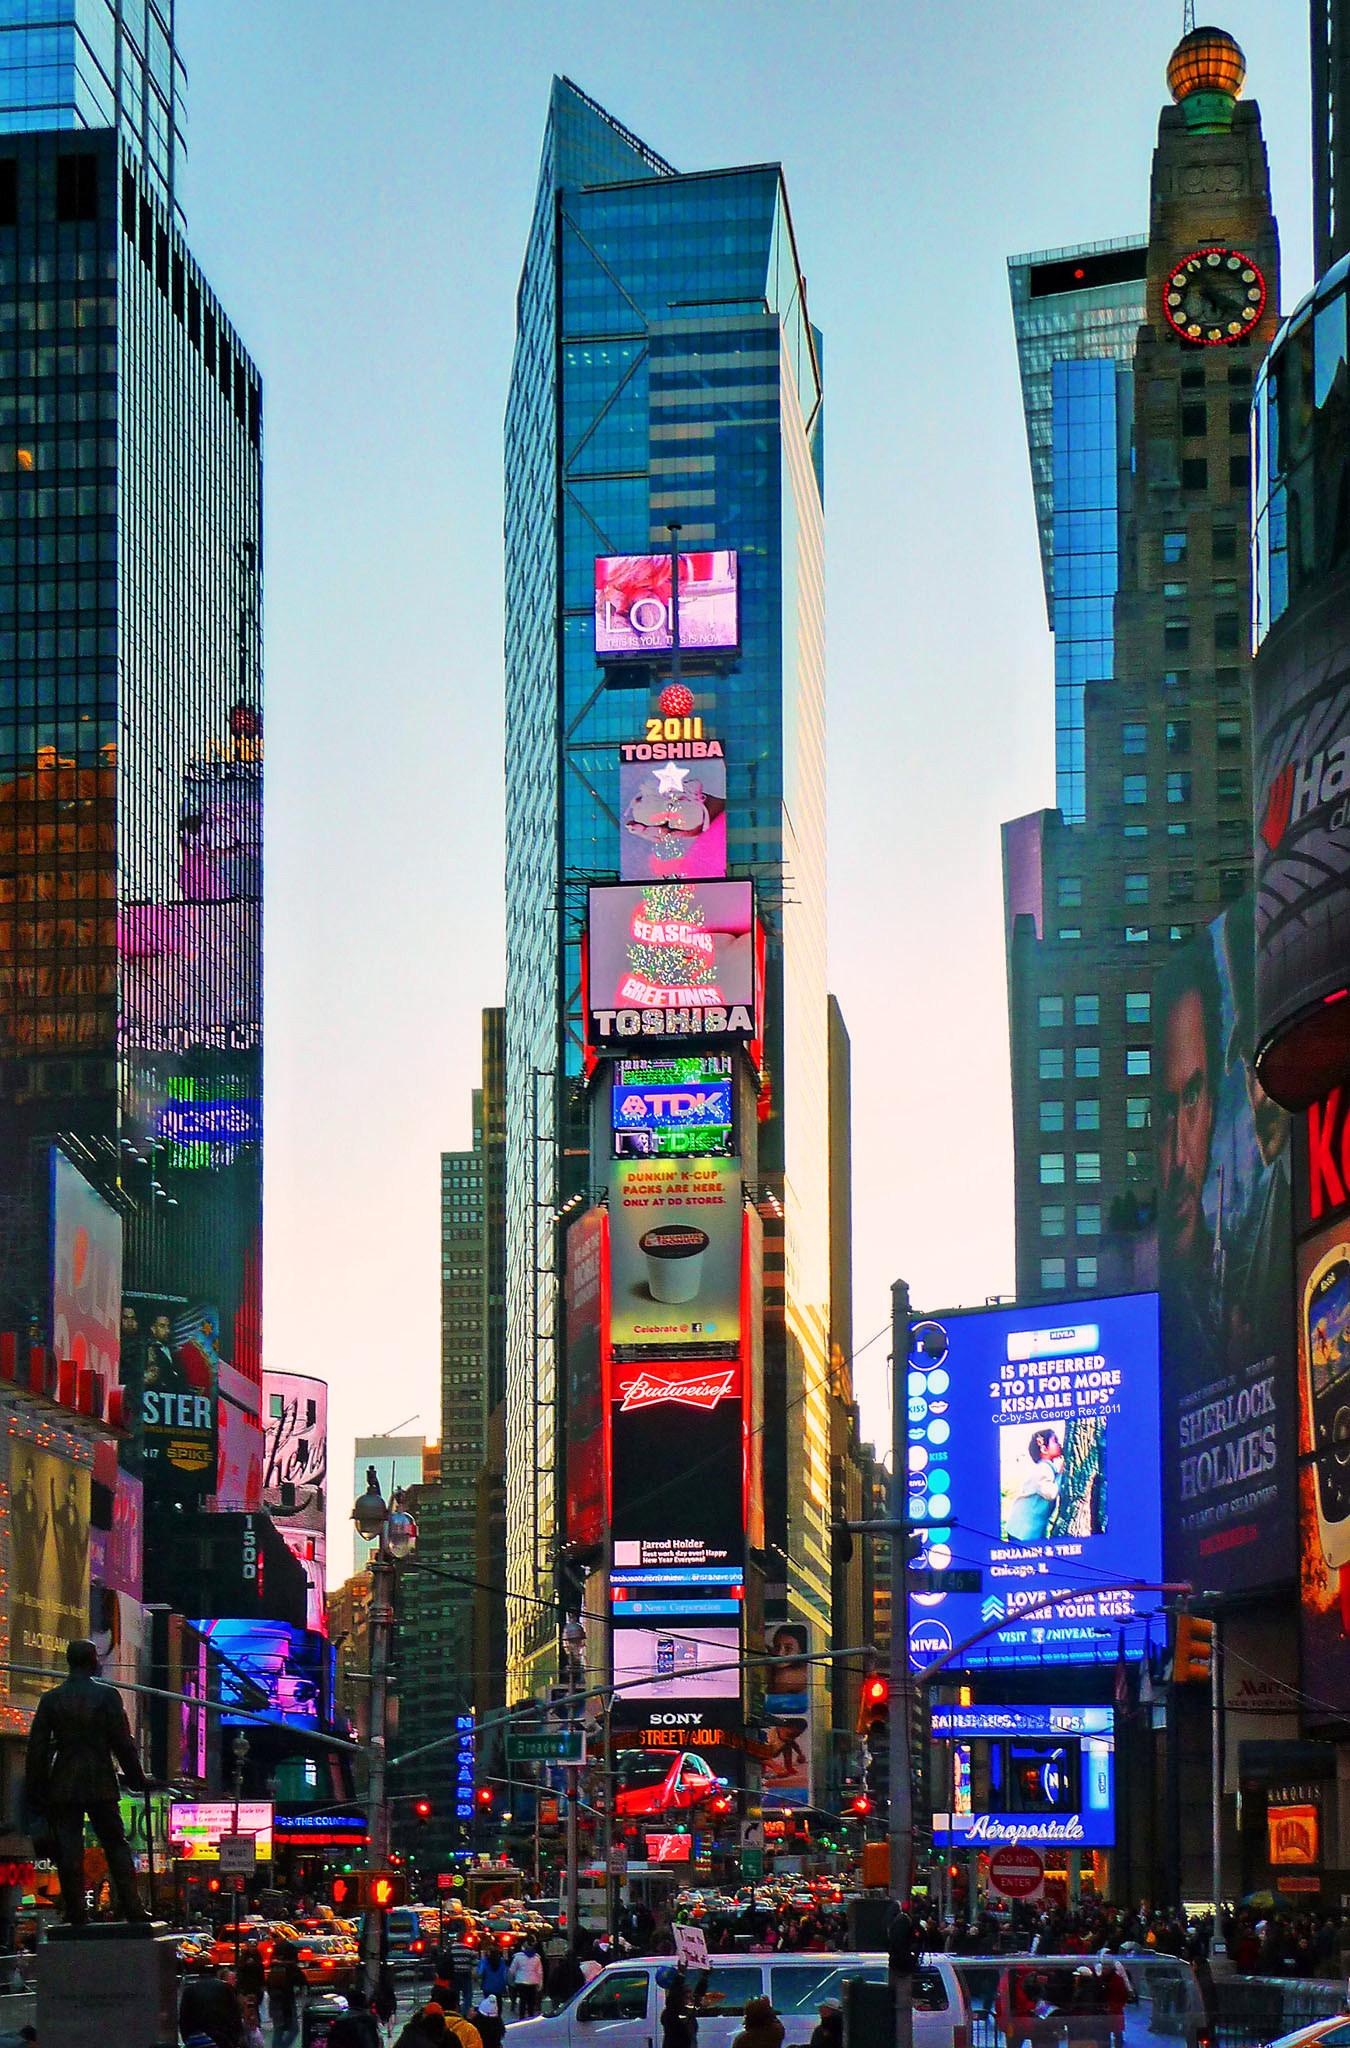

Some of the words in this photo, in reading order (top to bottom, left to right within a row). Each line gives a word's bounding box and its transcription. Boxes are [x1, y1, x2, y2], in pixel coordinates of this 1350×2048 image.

[645, 717, 703, 741] 2011
[622, 741, 723, 760] TOSHIBA
[633, 920, 713, 953] SEASONS
[622, 978, 723, 1005] GREETINGS
[593, 1006, 753, 1036] TOSHIBA
[644, 1092, 722, 1117] TDK
[627, 1172, 678, 1182] DUNKIN'
[681, 1171, 718, 1181] K-CUP
[623, 1184, 662, 1194] PACKS
[666, 1184, 690, 1193] ARE
[693, 1183, 725, 1192] HERE.
[623, 1198, 648, 1207] ONLY
[653, 1198, 664, 1206] AT
[669, 1198, 683, 1206] DD
[685, 1196, 726, 1205] STORES.
[633, 1323, 678, 1334] Celebrate
[1000, 1364, 1015, 1379] IS
[1019, 1356, 1105, 1377] PREFERRED
[620, 1380, 732, 1400] Budweiser
[989, 1384, 1000, 1397] 2
[1003, 1382, 1025, 1395] TO
[1028, 1379, 1034, 1392] 1
[1039, 1375, 1071, 1392] FOR
[1075, 1370, 1121, 1389] MORE
[1001, 1394, 1072, 1412] KISSABLE
[1179, 1376, 1276, 1449] SHERLOCK
[167, 1448, 214, 1462] SPIKE
[1180, 1424, 1277, 1500] HOLMES
[241, 1515, 257, 1579] 1500
[641, 1540, 672, 1550] Jarrod
[673, 1539, 704, 1548] Holder
[990, 1546, 1043, 1561] BENJAMIN
[1044, 1546, 1054, 1557] &
[1056, 1544, 1082, 1556] TREE
[675, 1550, 687, 1558] day
[706, 1550, 727, 1558] Happy
[1006, 1590, 1047, 1607] LOVE
[670, 1603, 721, 1613] Corporation
[1055, 1603, 1096, 1618] YOUR
[1100, 1602, 1135, 1616] KISS.
[998, 1631, 1028, 1642] VISIT
[910, 1639, 948, 1651] NIVEA
[650, 1713, 703, 1725] SONY
[639, 1729, 685, 1745] STREET
[517, 1740, 573, 1755] Broadway
[965, 1815, 1085, 1847] Aéropostale
[999, 1854, 1010, 1864] DO
[1015, 1854, 1034, 1864] NOT
[1000, 1878, 1031, 1887] ENTER
